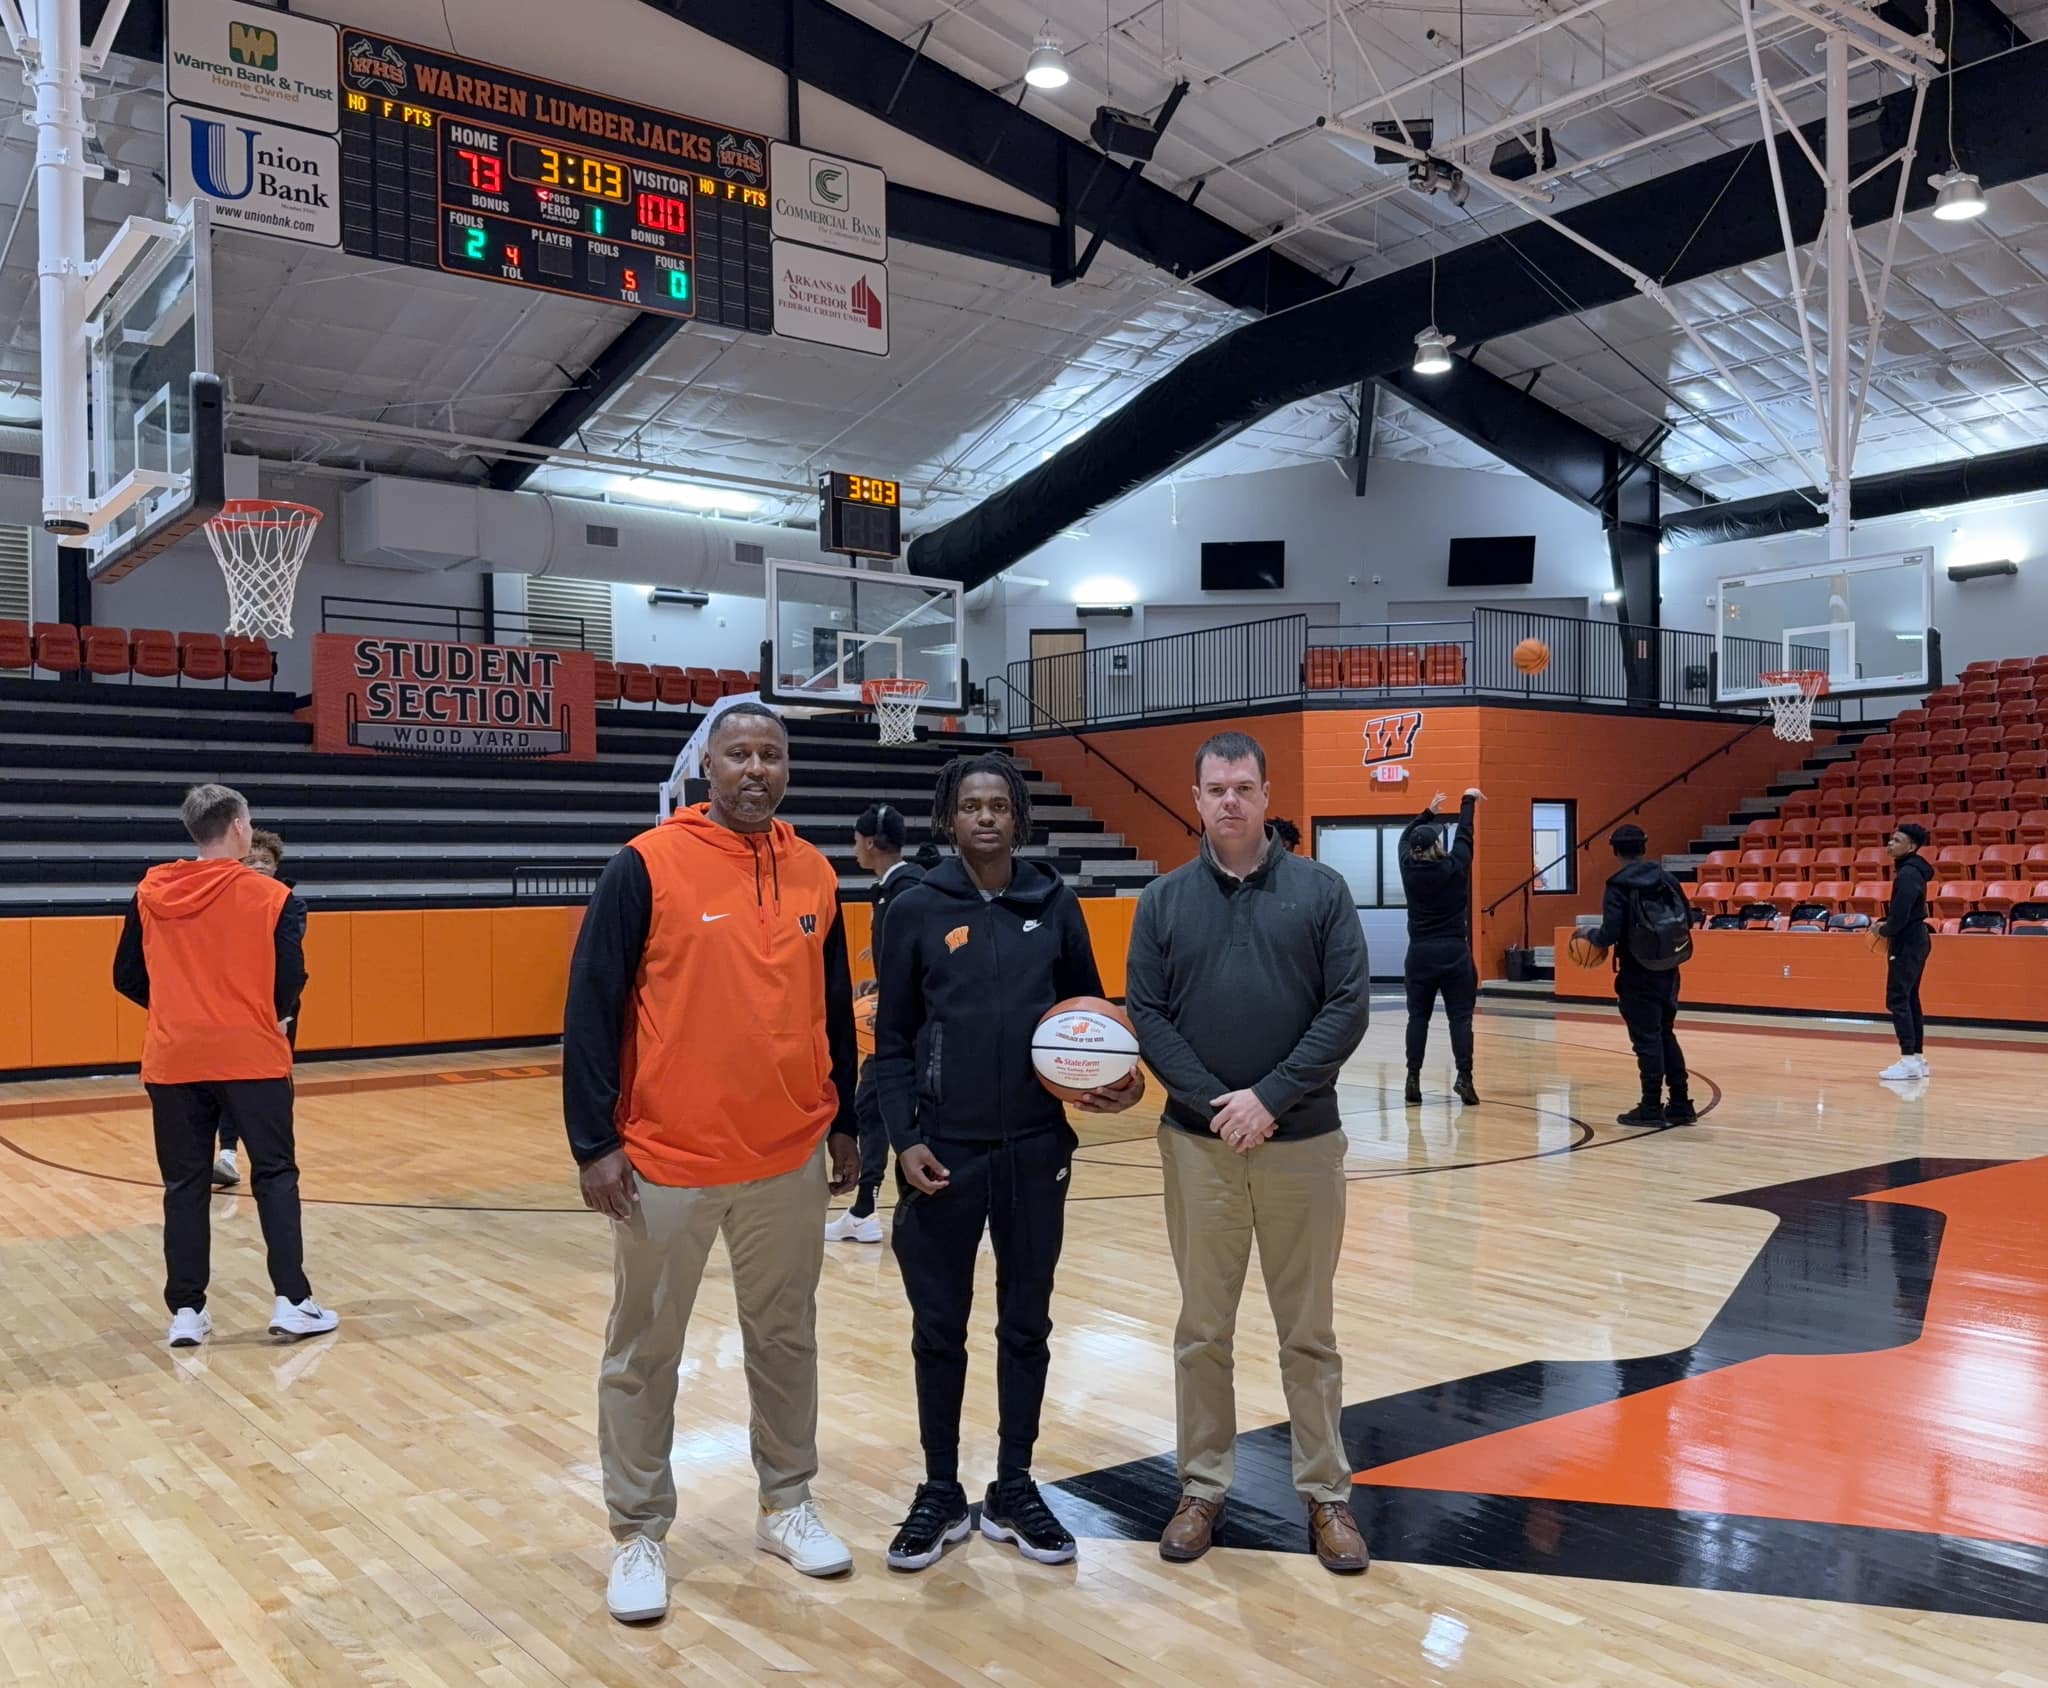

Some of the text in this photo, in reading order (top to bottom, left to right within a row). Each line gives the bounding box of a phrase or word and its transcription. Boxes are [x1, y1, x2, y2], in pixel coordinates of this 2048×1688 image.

[174, 52, 233, 77] Warren
[237, 67, 276, 87] Bank
[279, 77, 291, 91] &
[294, 80, 334, 101] Trust
[351, 56, 405, 85] WHS
[212, 75, 251, 90] Home
[255, 85, 299, 103] Owned
[384, 102, 394, 117] F
[404, 107, 432, 127] PTS
[413, 64, 712, 164] WARREN LUMBERJACKS
[451, 125, 498, 151] HOME
[180, 114, 320, 200] Union
[719, 150, 762, 174] WHS
[459, 150, 501, 192] 73
[540, 148, 622, 198] 3:03
[633, 168, 689, 196] VISITOR
[258, 172, 330, 208] Bank
[472, 194, 510, 213] BONUS
[549, 192, 570, 205] POSS
[727, 184, 737, 200] F
[743, 189, 768, 207] PTS
[216, 204, 315, 233] wwwunionbnk.com
[450, 212, 484, 229] FOULS
[540, 201, 580, 220] PERIOD
[595, 207, 603, 234] 1
[639, 193, 685, 233] 100
[776, 198, 881, 239] COMMERCIAL BANK
[467, 229, 486, 259] 2
[531, 229, 573, 248] PLAYER
[588, 241, 620, 257] FOULS
[631, 229, 665, 247] BONUS
[506, 247, 518, 265] 4
[655, 255, 686, 271] FOULS
[502, 265, 524, 280] TOL
[671, 270, 687, 299] 0
[783, 268, 847, 295] ARKANSAS
[621, 289, 641, 304] TOL
[788, 284, 848, 310] SUPERIOR
[778, 298, 867, 324] FEDERAL CREDIT UNION
[849, 476, 896, 505] 3:03
[354, 639, 562, 688] STUDENT
[366, 681, 553, 726] SECTION
[393, 727, 530, 747] WOOD YARD
[1362, 711, 1423, 766] W
[1381, 766, 1399, 780] EXIT
